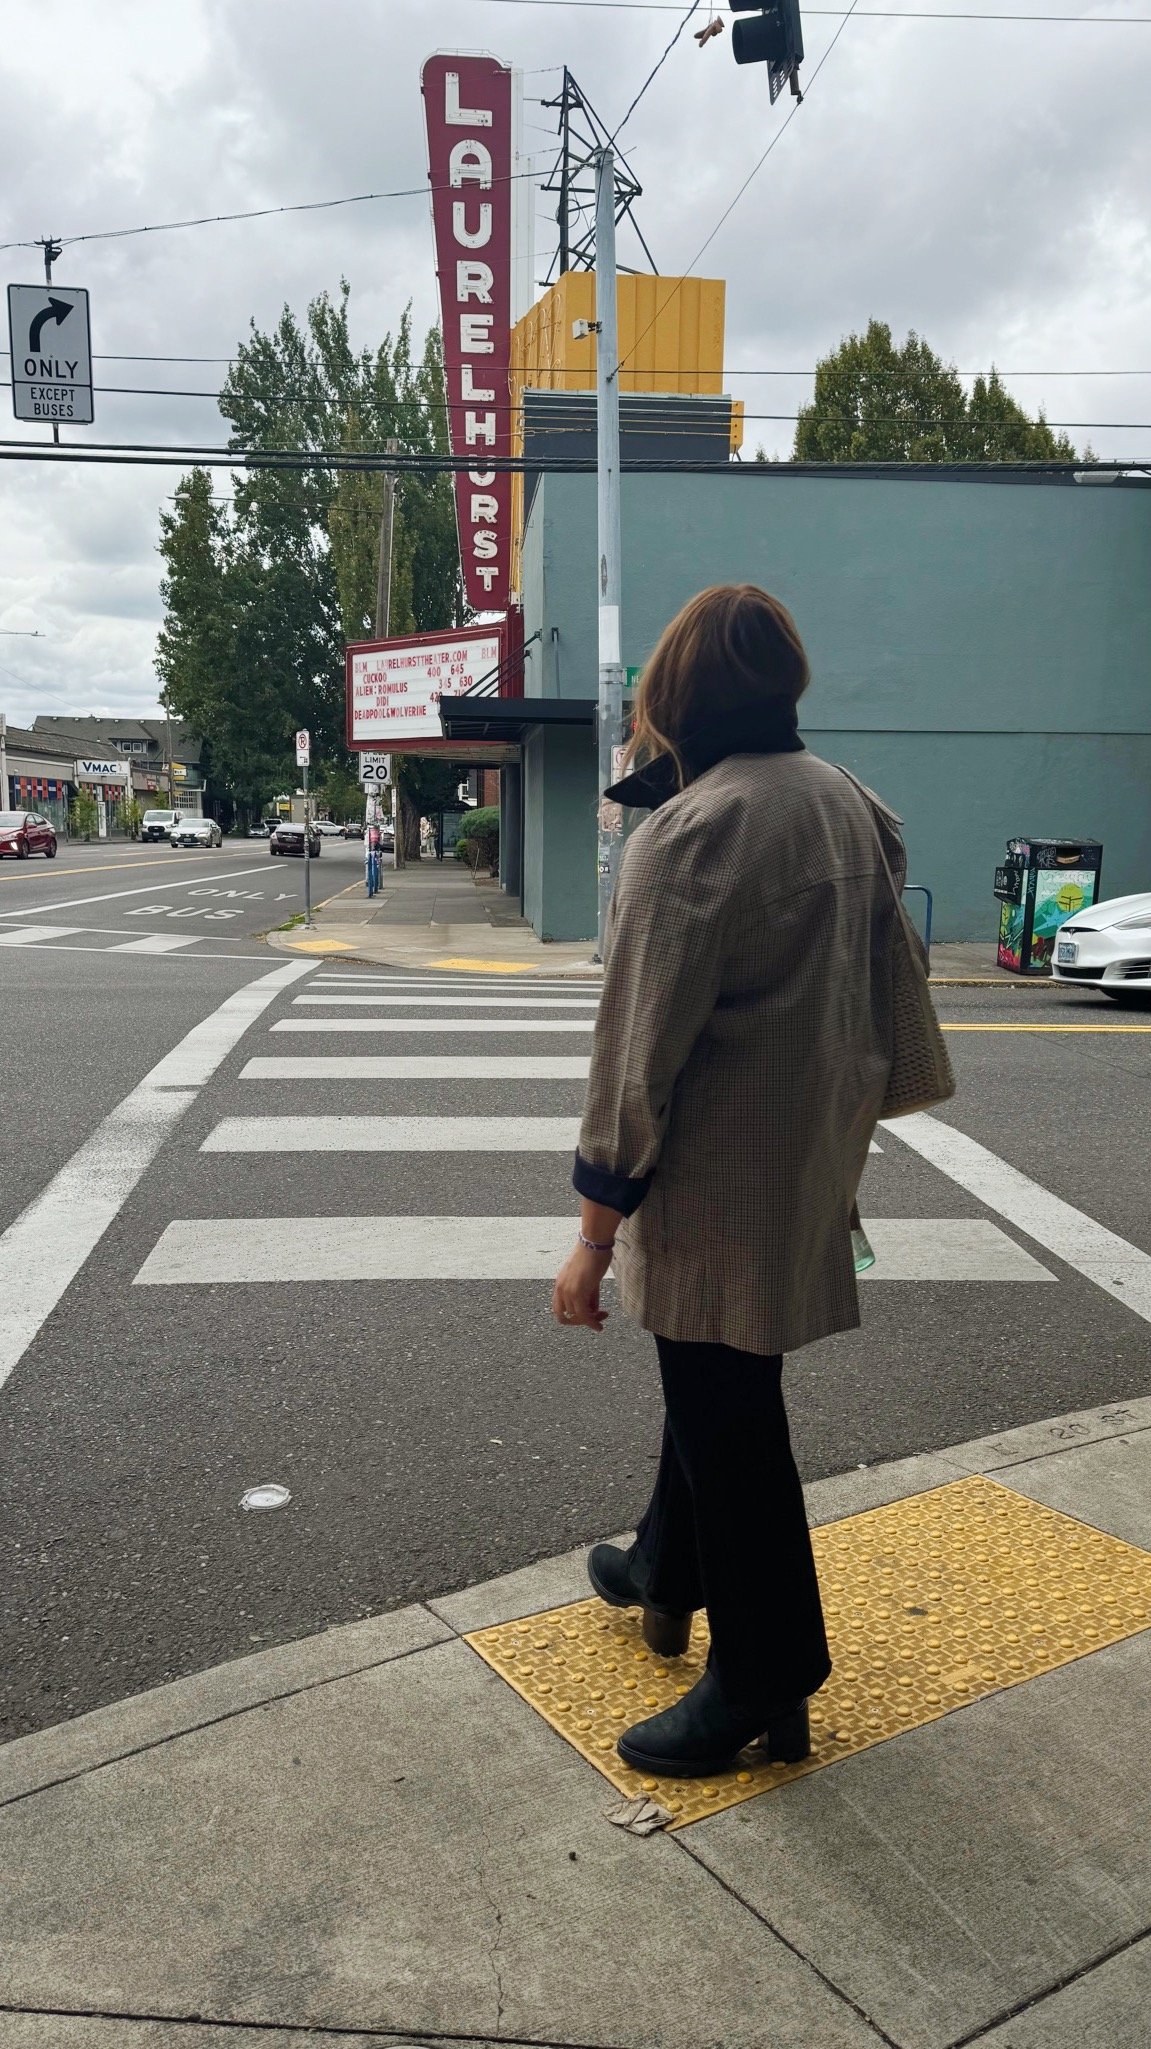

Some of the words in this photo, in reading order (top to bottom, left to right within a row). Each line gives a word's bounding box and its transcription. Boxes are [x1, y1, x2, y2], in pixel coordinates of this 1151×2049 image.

[445, 72, 498, 591] LAURELHURST
[24, 358, 78, 378] ONLY
[31, 387, 75, 402] EXCEPT
[34, 403, 74, 417] BUSES
[363, 672, 387, 684] CUCKOO
[376, 695, 389, 707] DIDI
[82, 761, 117, 773] VMAC
[365, 756, 385, 764] LIMIT
[362, 764, 387, 779] 20
[187, 888, 298, 901] ONLY
[123, 905, 245, 920] BUS
